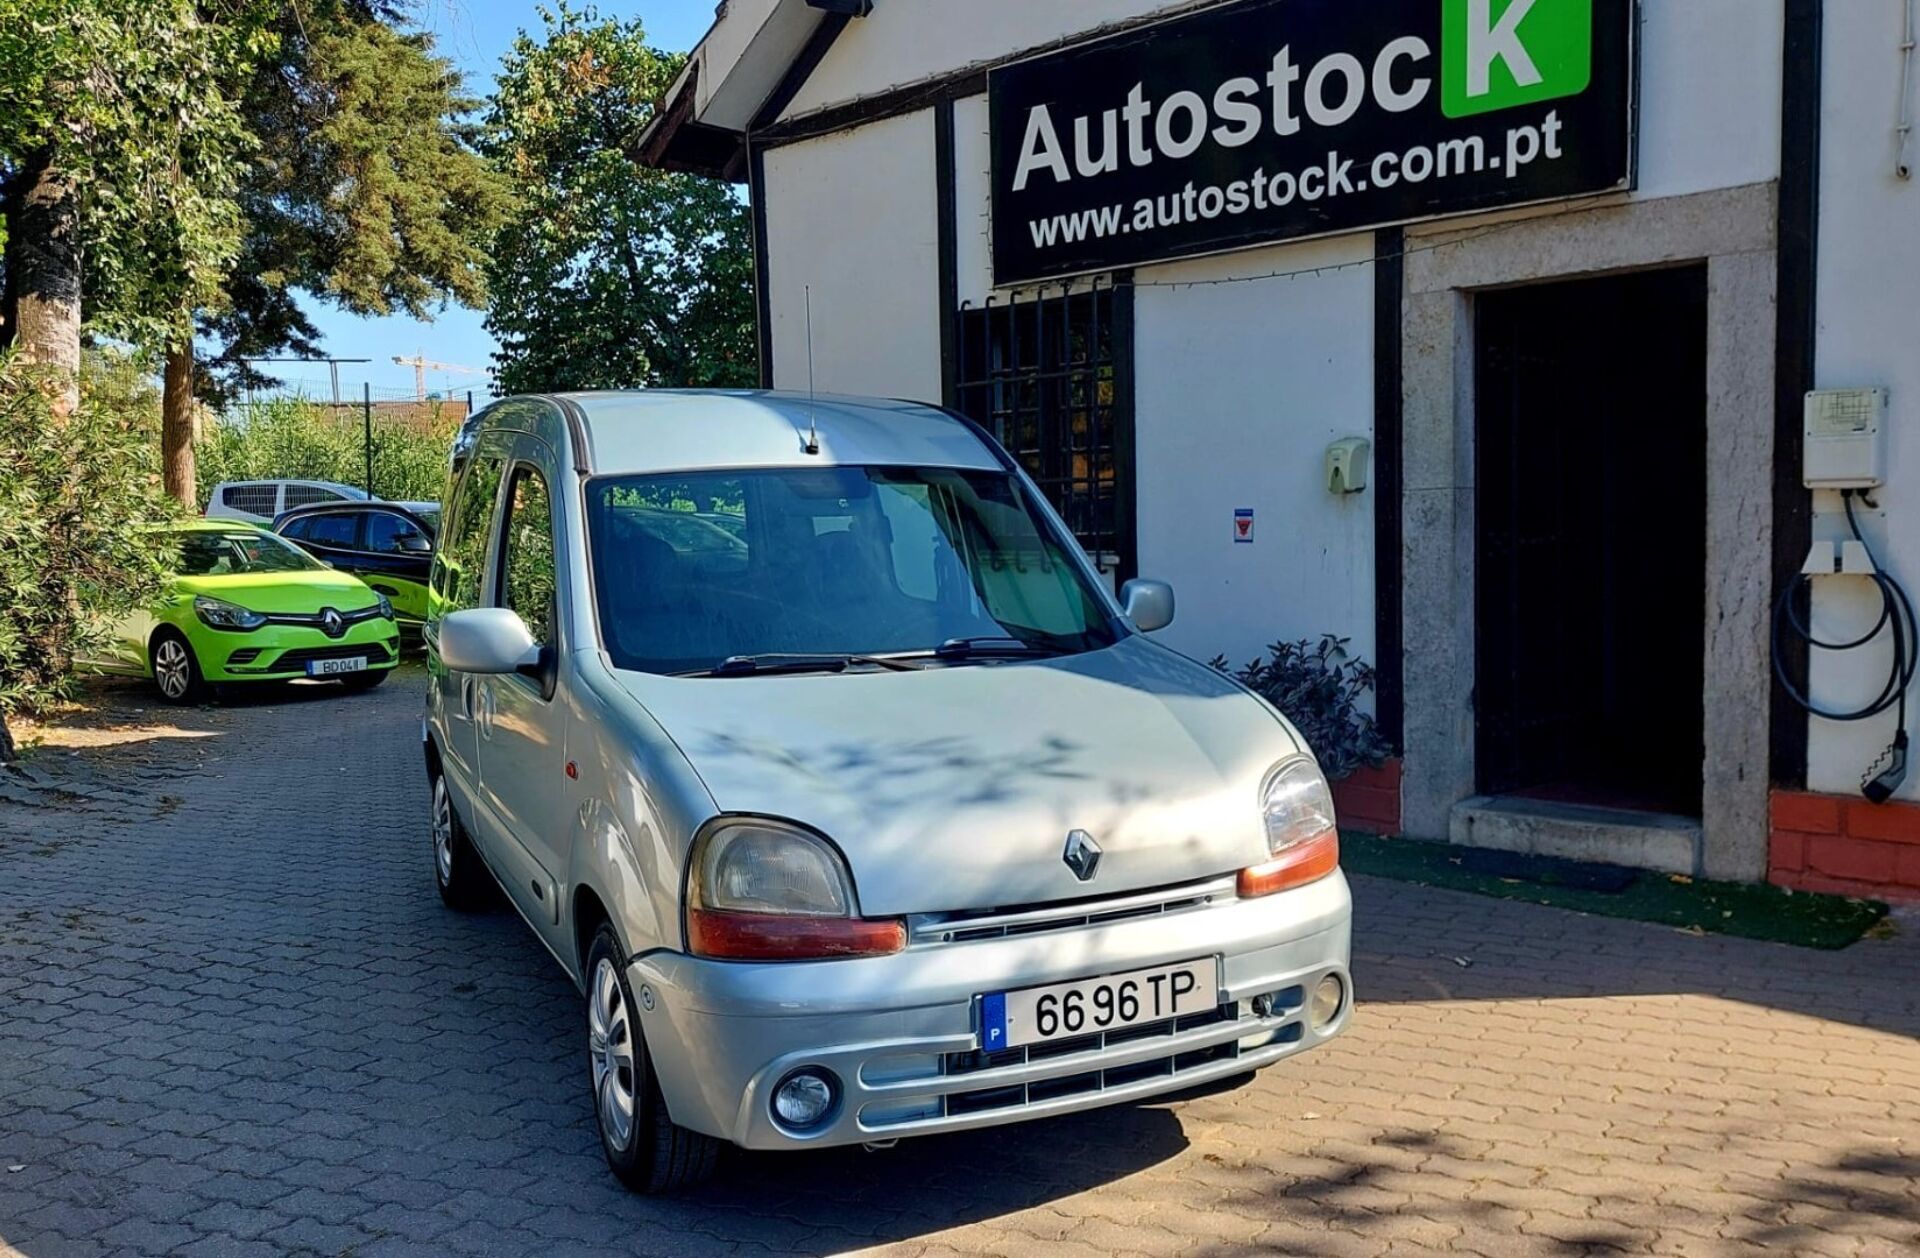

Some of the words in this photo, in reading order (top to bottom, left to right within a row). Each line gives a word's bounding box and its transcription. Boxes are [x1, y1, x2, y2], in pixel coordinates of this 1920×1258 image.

[1029, 109, 1563, 248] www.autostock.com.pt
[1147, 970, 1196, 1017] TP
[991, 1028, 1000, 1041] P
